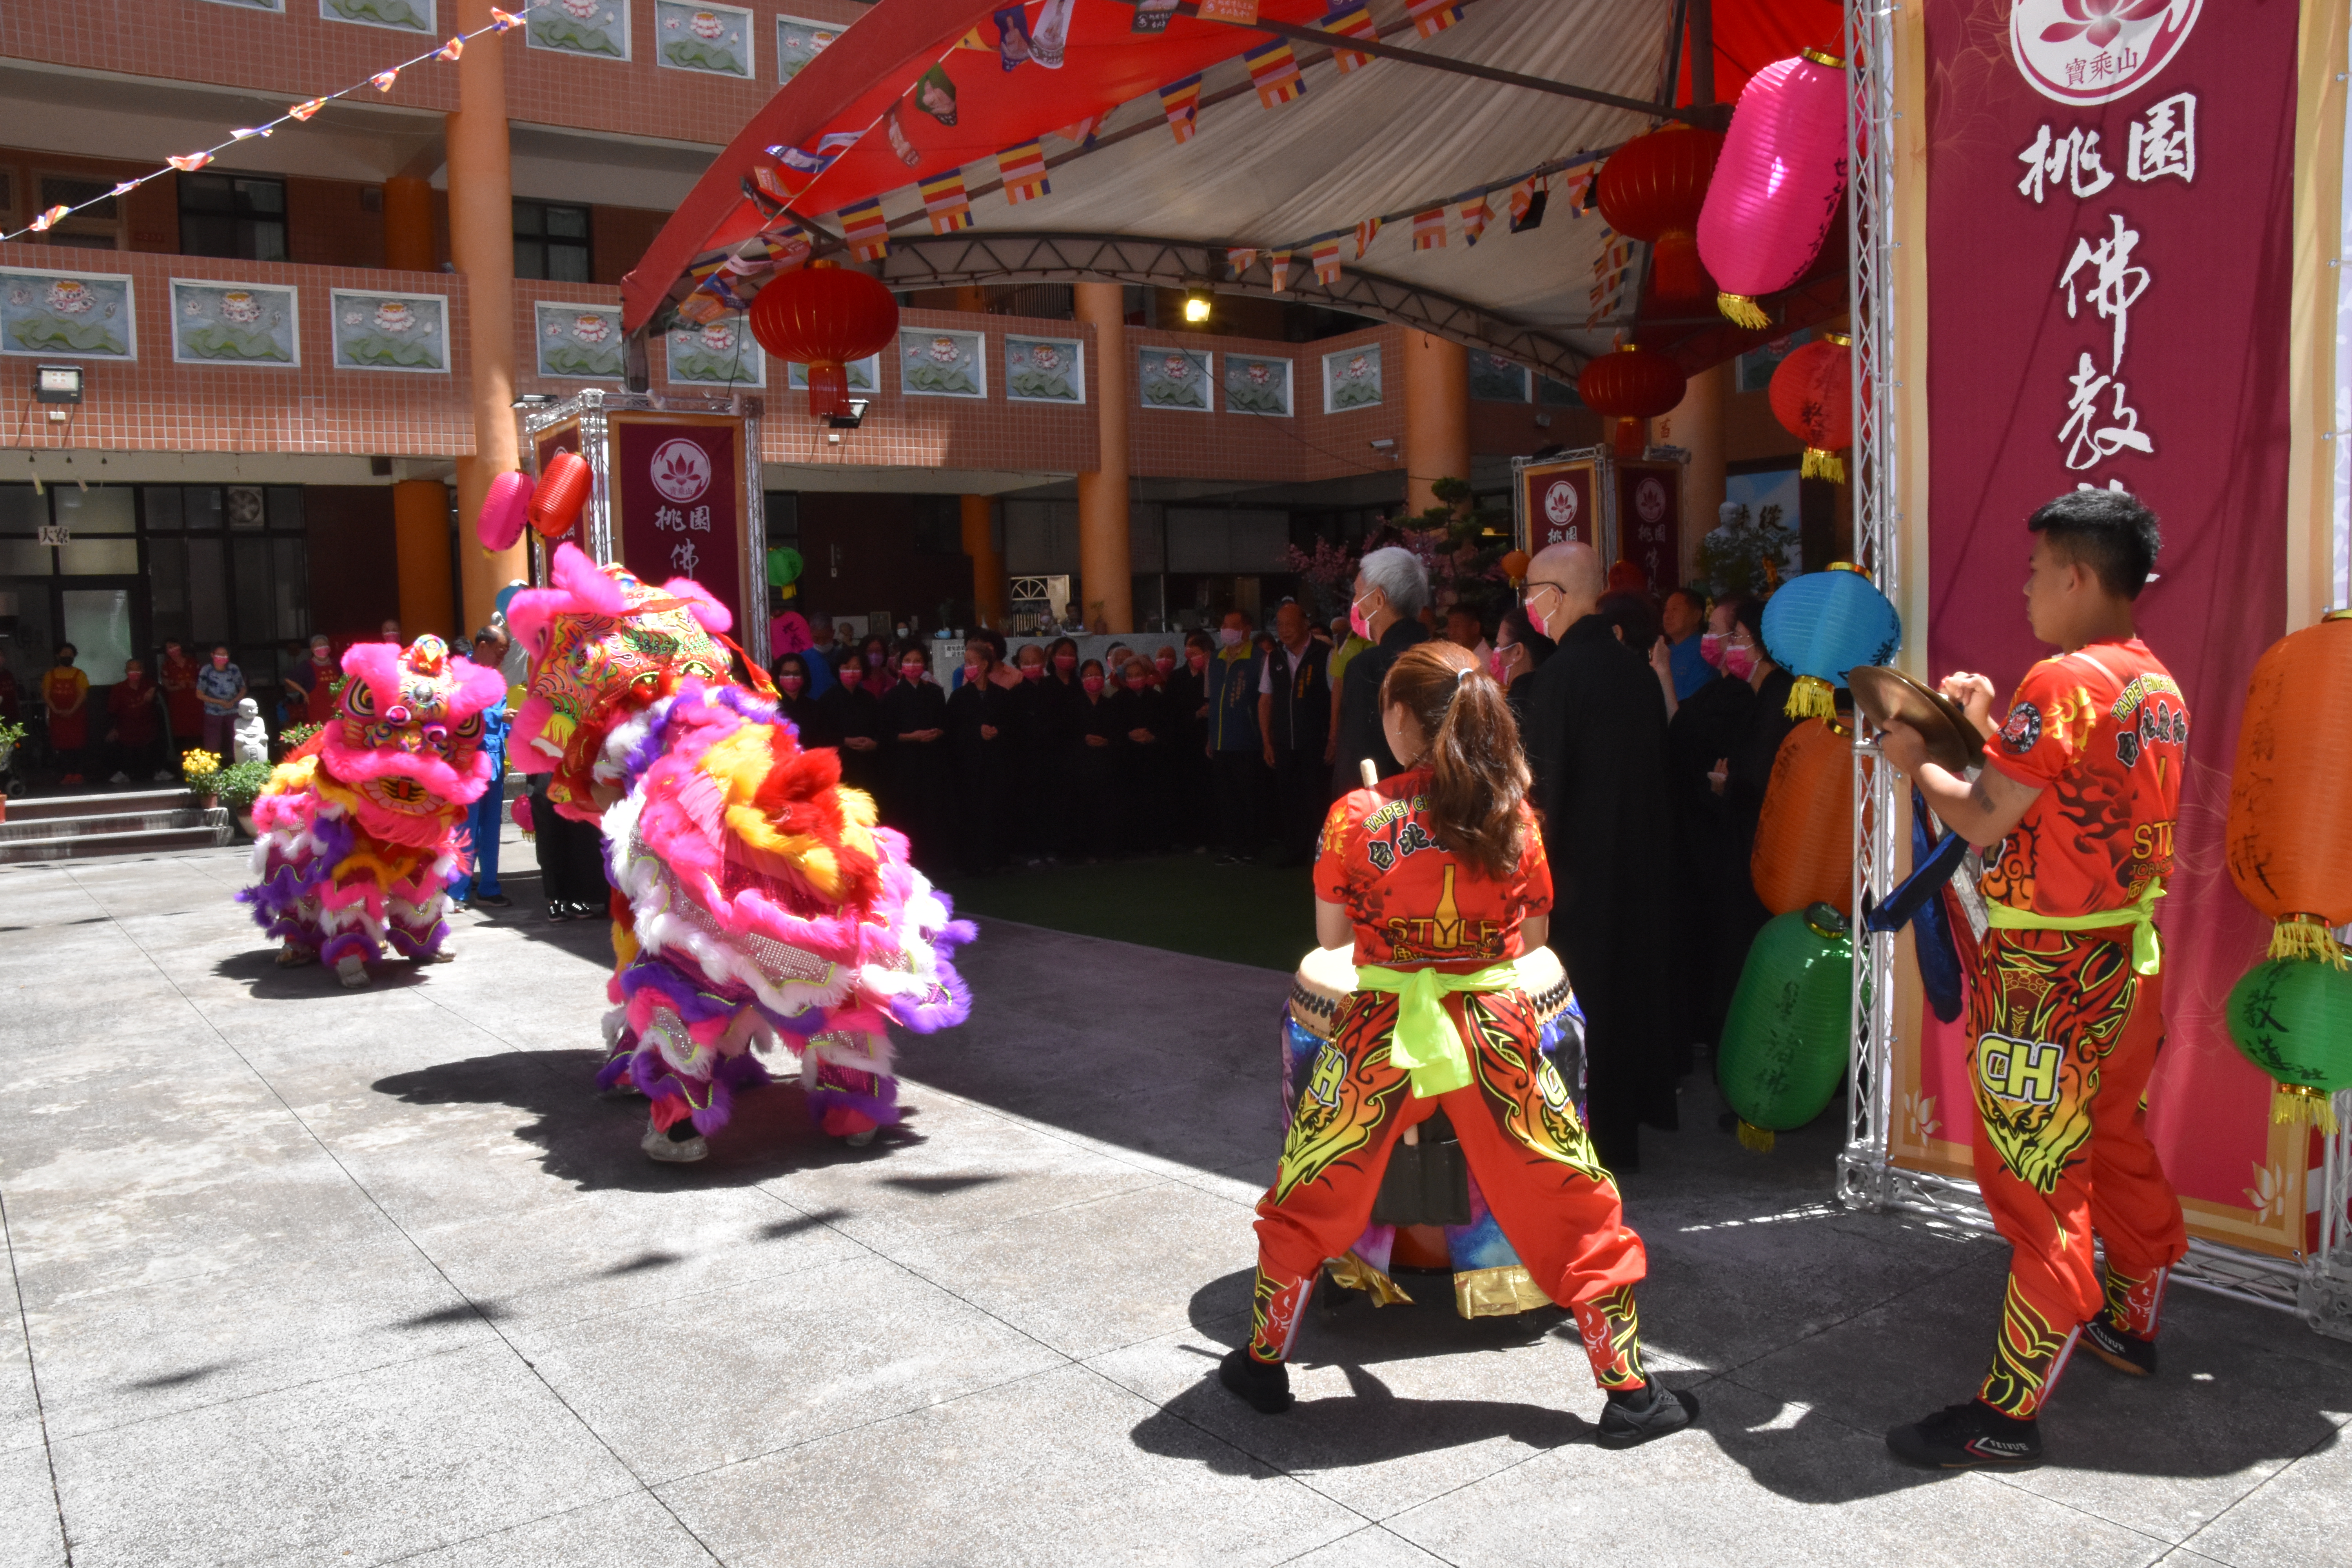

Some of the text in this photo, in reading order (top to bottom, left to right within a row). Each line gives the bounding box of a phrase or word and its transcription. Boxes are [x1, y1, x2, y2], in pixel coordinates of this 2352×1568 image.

[2065, 47, 2138, 88] 寶乘山
[2017, 92, 2197, 204] 桃園
[2058, 214, 2154, 495] 佛教
[655, 505, 711, 534] 桃園
[2111, 678, 2145, 723] TAIPEI
[1362, 800, 1410, 833] TAIPEI
[1978, 1033, 2062, 1104] CH
